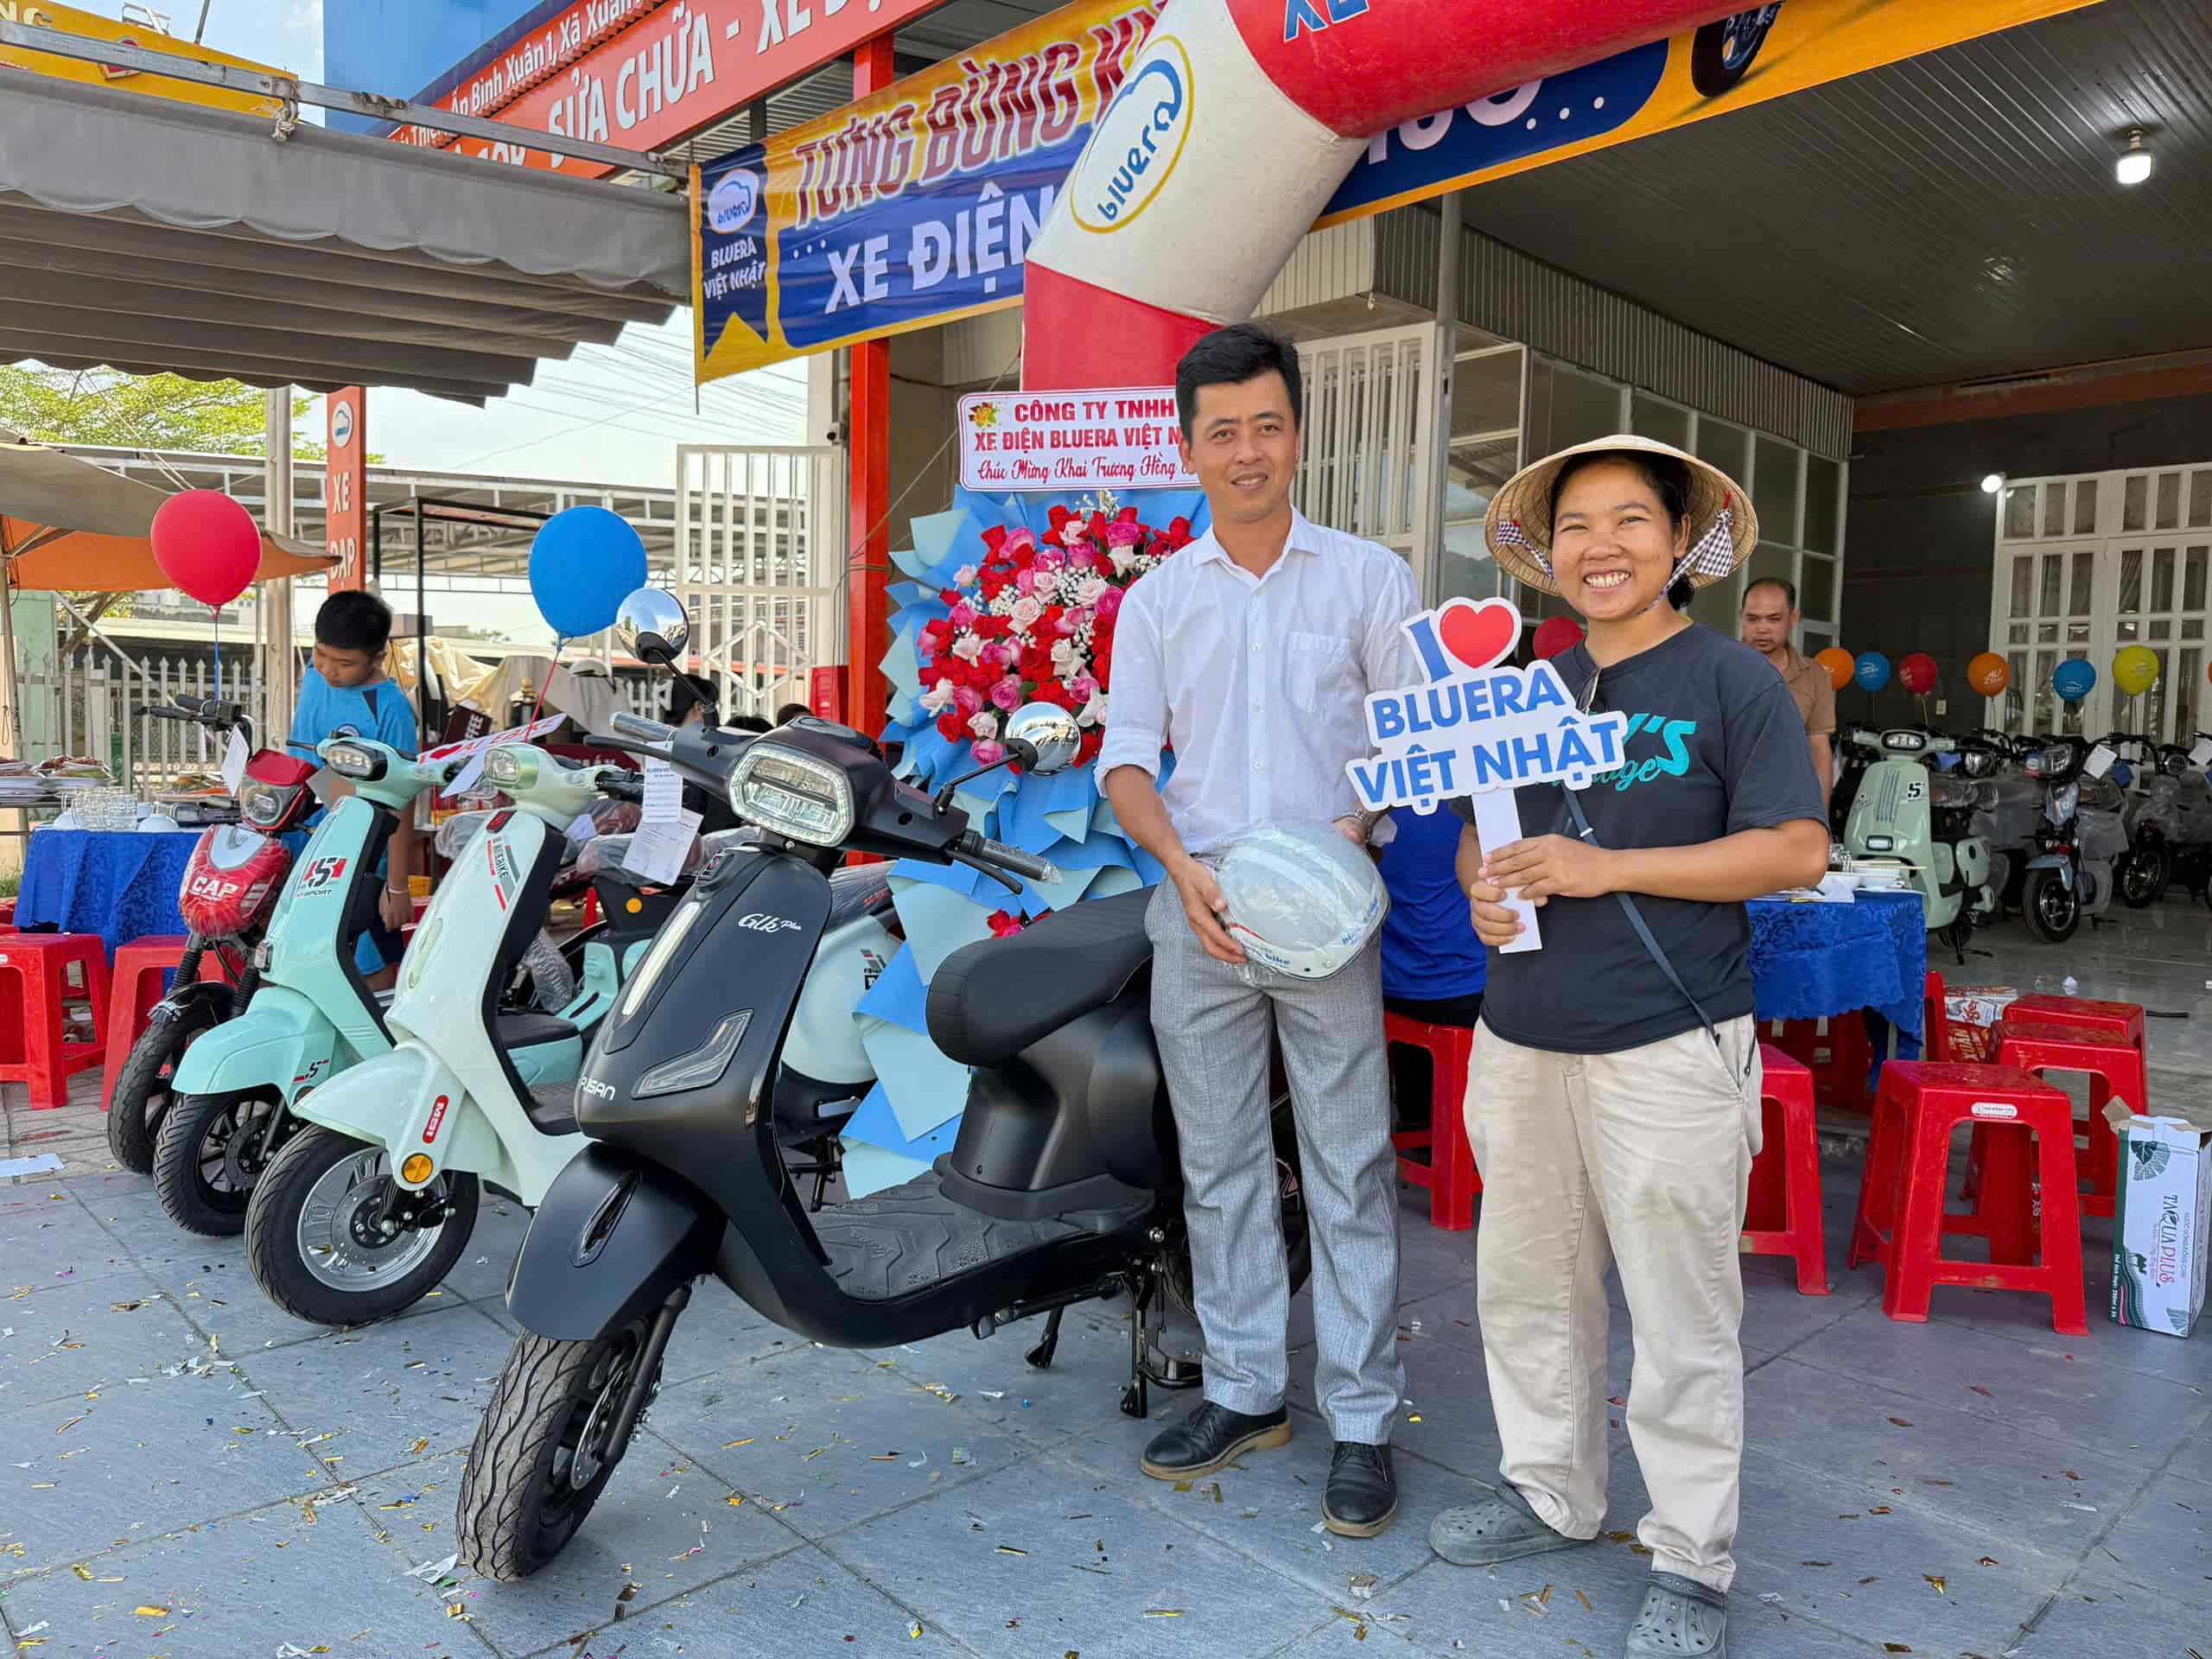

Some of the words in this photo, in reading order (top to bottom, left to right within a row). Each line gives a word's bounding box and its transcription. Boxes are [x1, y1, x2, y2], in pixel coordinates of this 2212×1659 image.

[558, 12, 582, 54] Xã
[547, 67, 609, 168] SỬA
[614, 2, 715, 130] CHỮA
[710, 236, 758, 269] BLUERA
[823, 234, 889, 315] XE
[907, 181, 1054, 293] ĐIỆN
[703, 271, 727, 301] VIỆT
[729, 261, 767, 291] NHẬT
[1014, 400, 1076, 423] CÔNG
[1083, 401, 1108, 420] TY
[1116, 398, 1175, 418] TNHH
[975, 431, 997, 451] XE
[1002, 427, 1045, 454] ĐIỆN
[1050, 428, 1118, 448] BLUERA
[1124, 423, 1162, 450] VIỆT
[332, 470, 350, 514] XE
[1409, 616, 1452, 683] I
[1371, 668, 1566, 740] BLUERA
[1354, 744, 1457, 807] VIỆT
[1472, 716, 1618, 785] NHẬT
